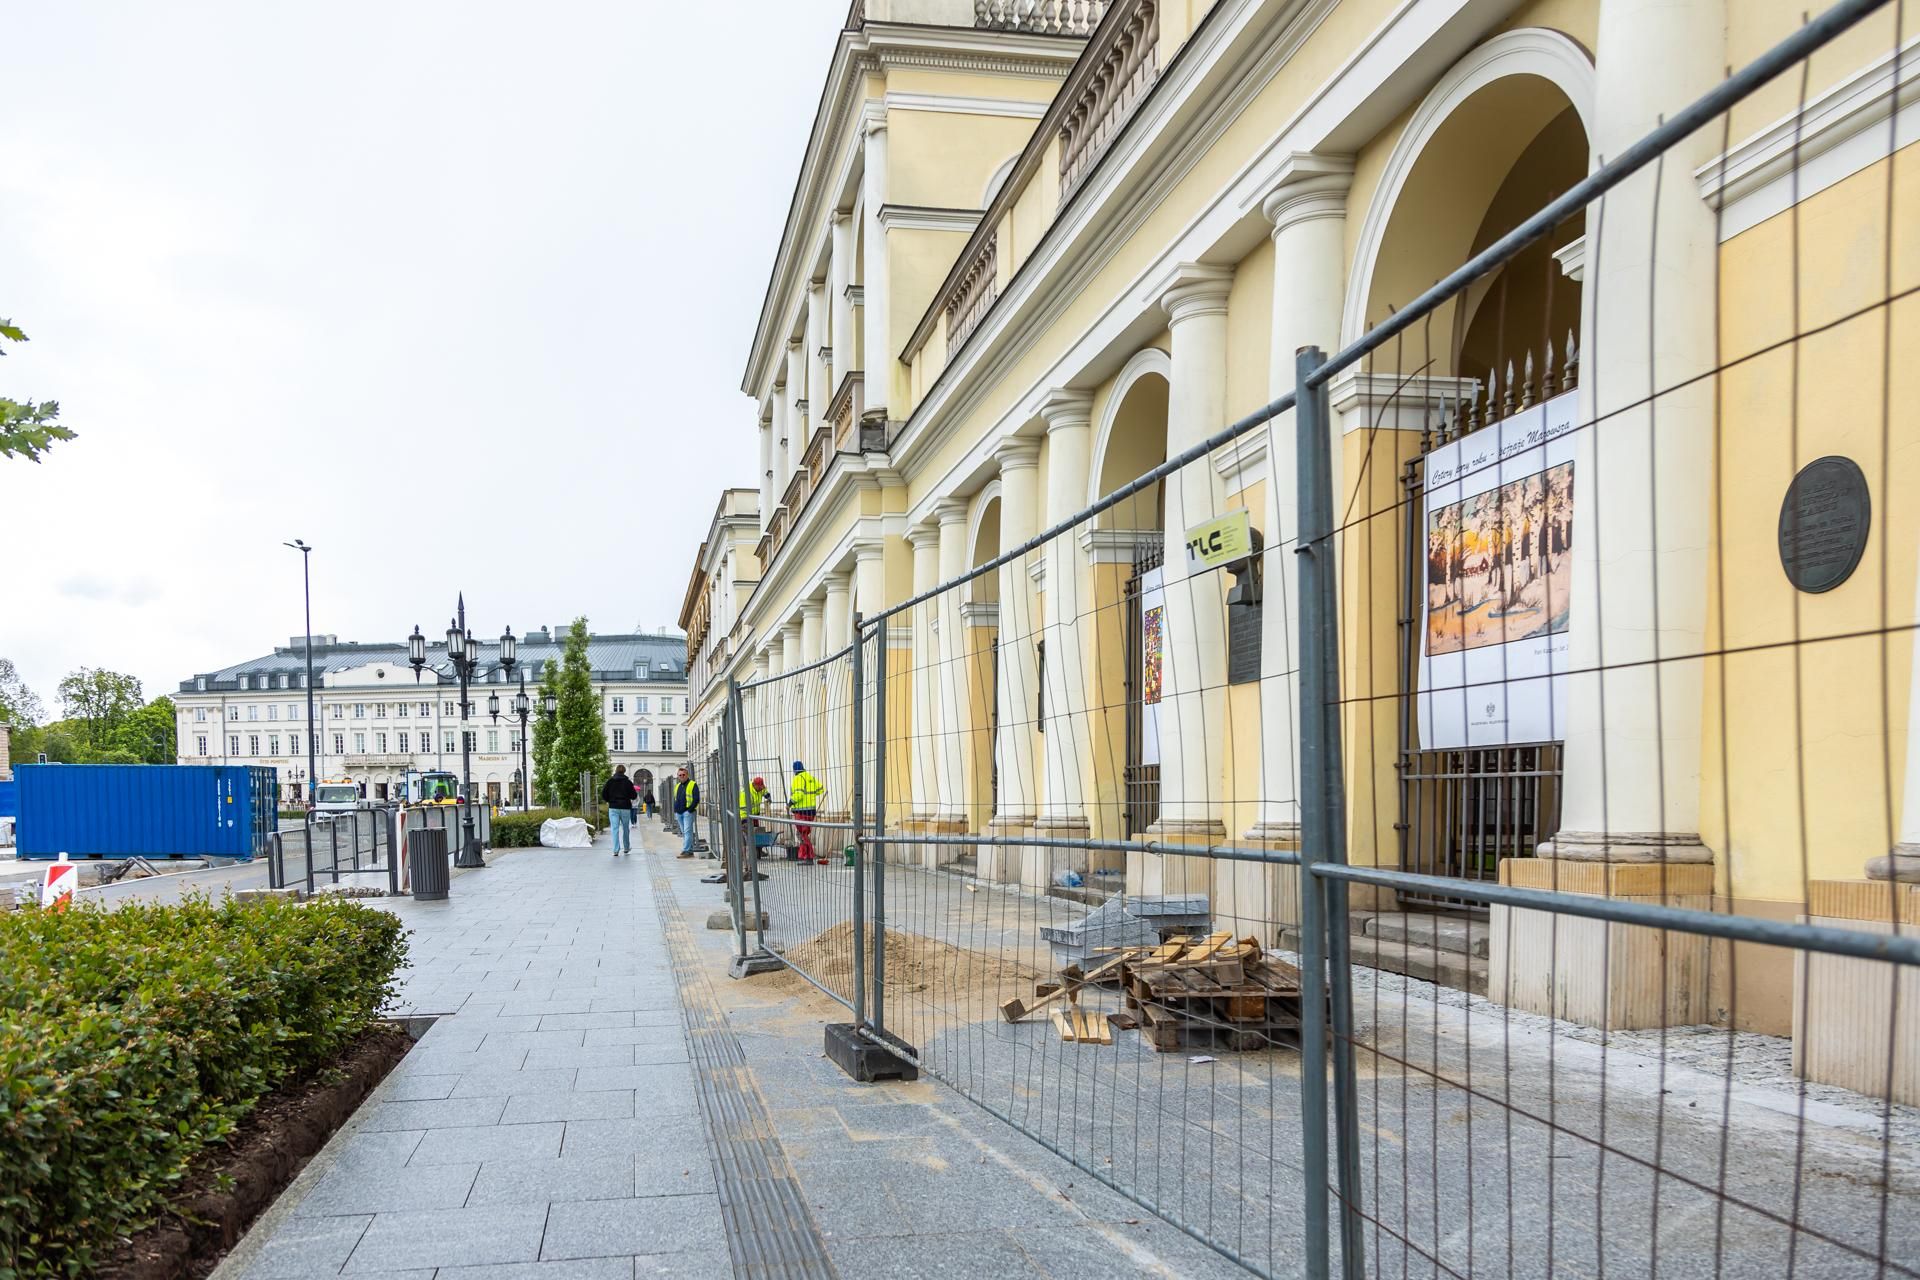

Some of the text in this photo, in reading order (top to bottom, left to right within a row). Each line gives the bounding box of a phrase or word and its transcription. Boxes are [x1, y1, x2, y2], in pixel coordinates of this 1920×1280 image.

[1431, 468, 1453, 485] Cztery
[1455, 462, 1469, 477] pory
[1472, 451, 1487, 466] roku
[1526, 421, 1570, 446] Mazowsza
[1186, 530, 1222, 560] TLC
